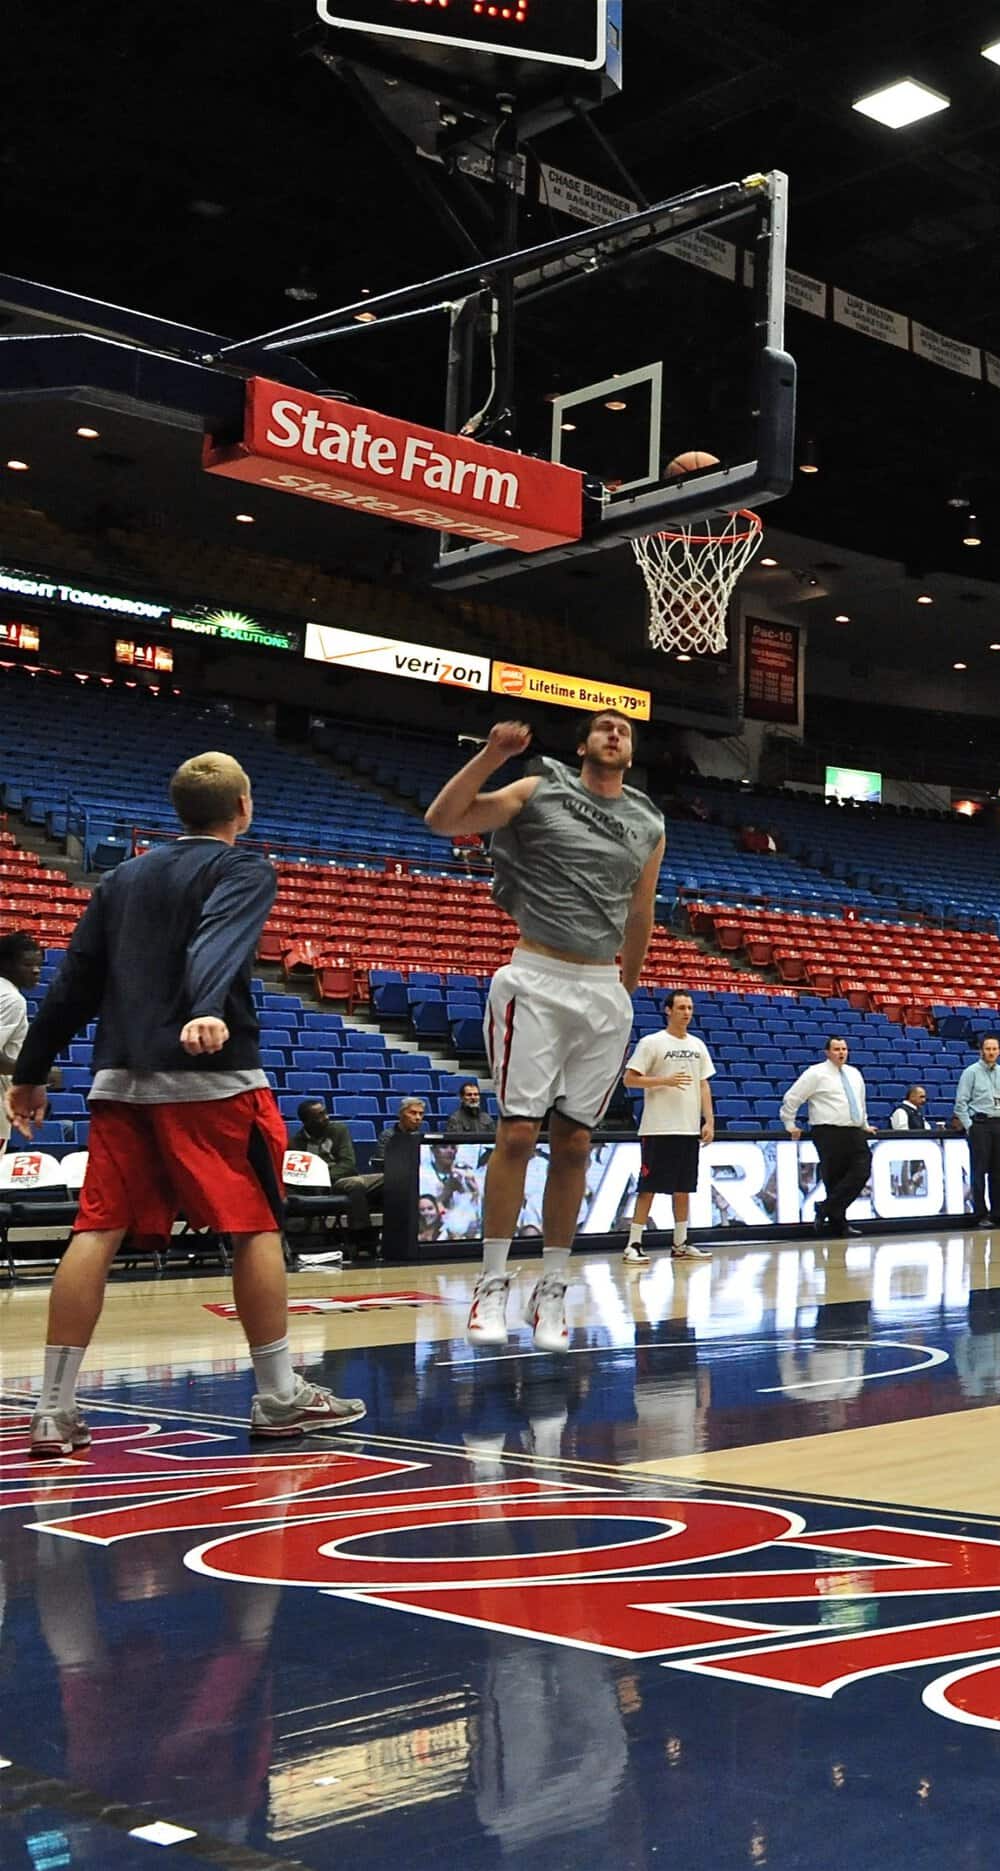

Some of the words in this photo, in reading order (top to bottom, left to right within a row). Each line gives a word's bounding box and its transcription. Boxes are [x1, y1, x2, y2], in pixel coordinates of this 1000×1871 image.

[549, 171, 581, 192] CHASE
[266, 400, 397, 475] State
[400, 436, 521, 509] Farm
[260, 475, 400, 512] State
[393, 508, 520, 542] Farm
[220, 626, 289, 649] SOLUTIONS
[394, 653, 482, 686] verizon
[529, 679, 575, 699] Lifetime
[579, 689, 617, 708] Brakes
